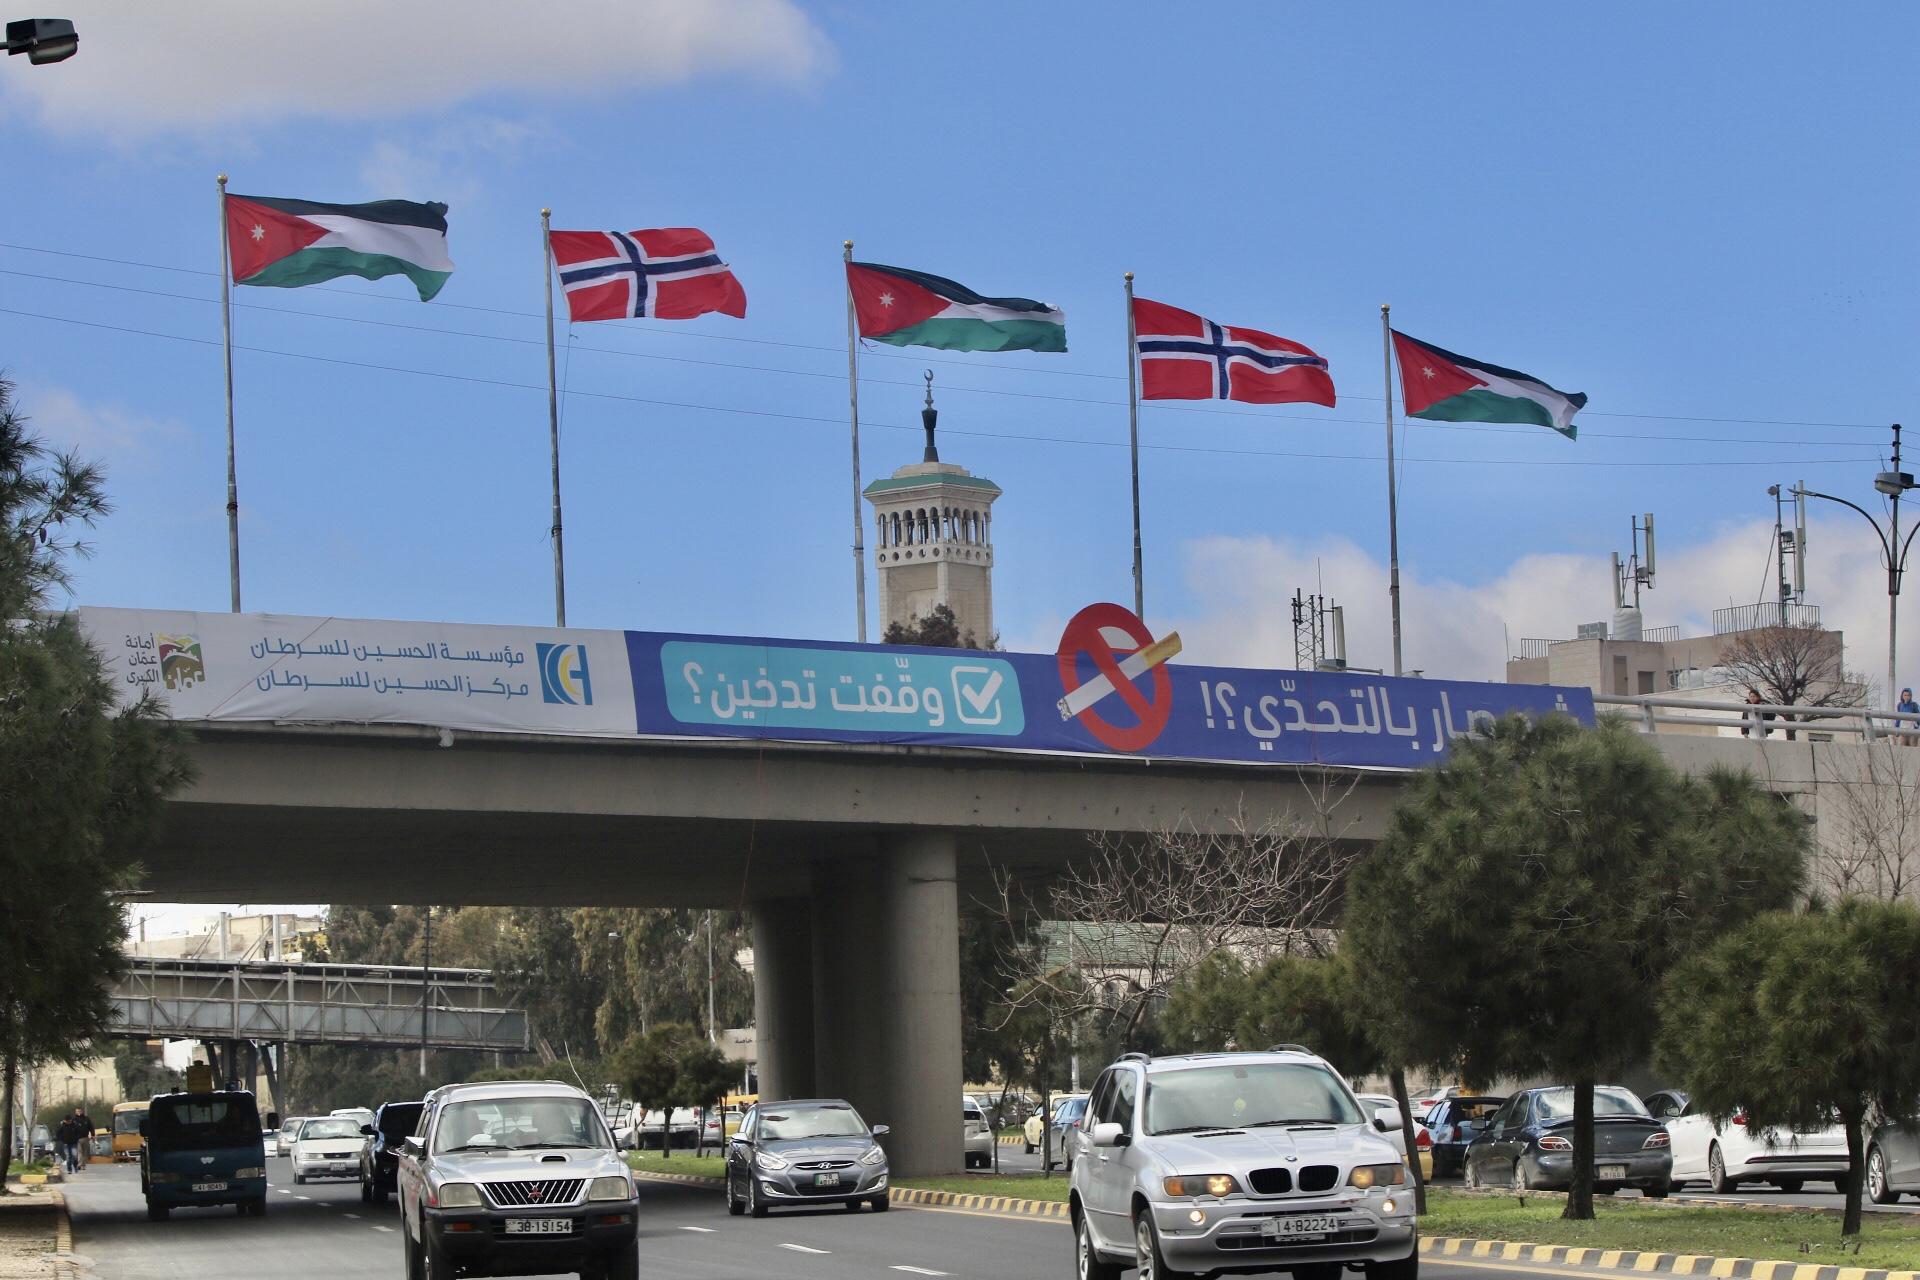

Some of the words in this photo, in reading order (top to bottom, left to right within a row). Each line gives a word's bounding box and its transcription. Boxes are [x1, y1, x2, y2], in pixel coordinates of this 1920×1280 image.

[125, 632, 155, 650] أمانة
[250, 637, 349, 660] للسرطان
[353, 642, 438, 662] الحسين
[441, 642, 525, 669] مؤسسة
[126, 668, 160, 686] الكبرى
[257, 669, 369, 692] للسرطان
[374, 674, 463, 695] الحسين
[466, 675, 529, 700] مركز
[683, 661, 816, 719] تدخين؟
[830, 656, 945, 727] وقّفت
[1200, 679, 1418, 751] بالتحدّي؟!
[1275, 1217, 1336, 1233] 14-82224
